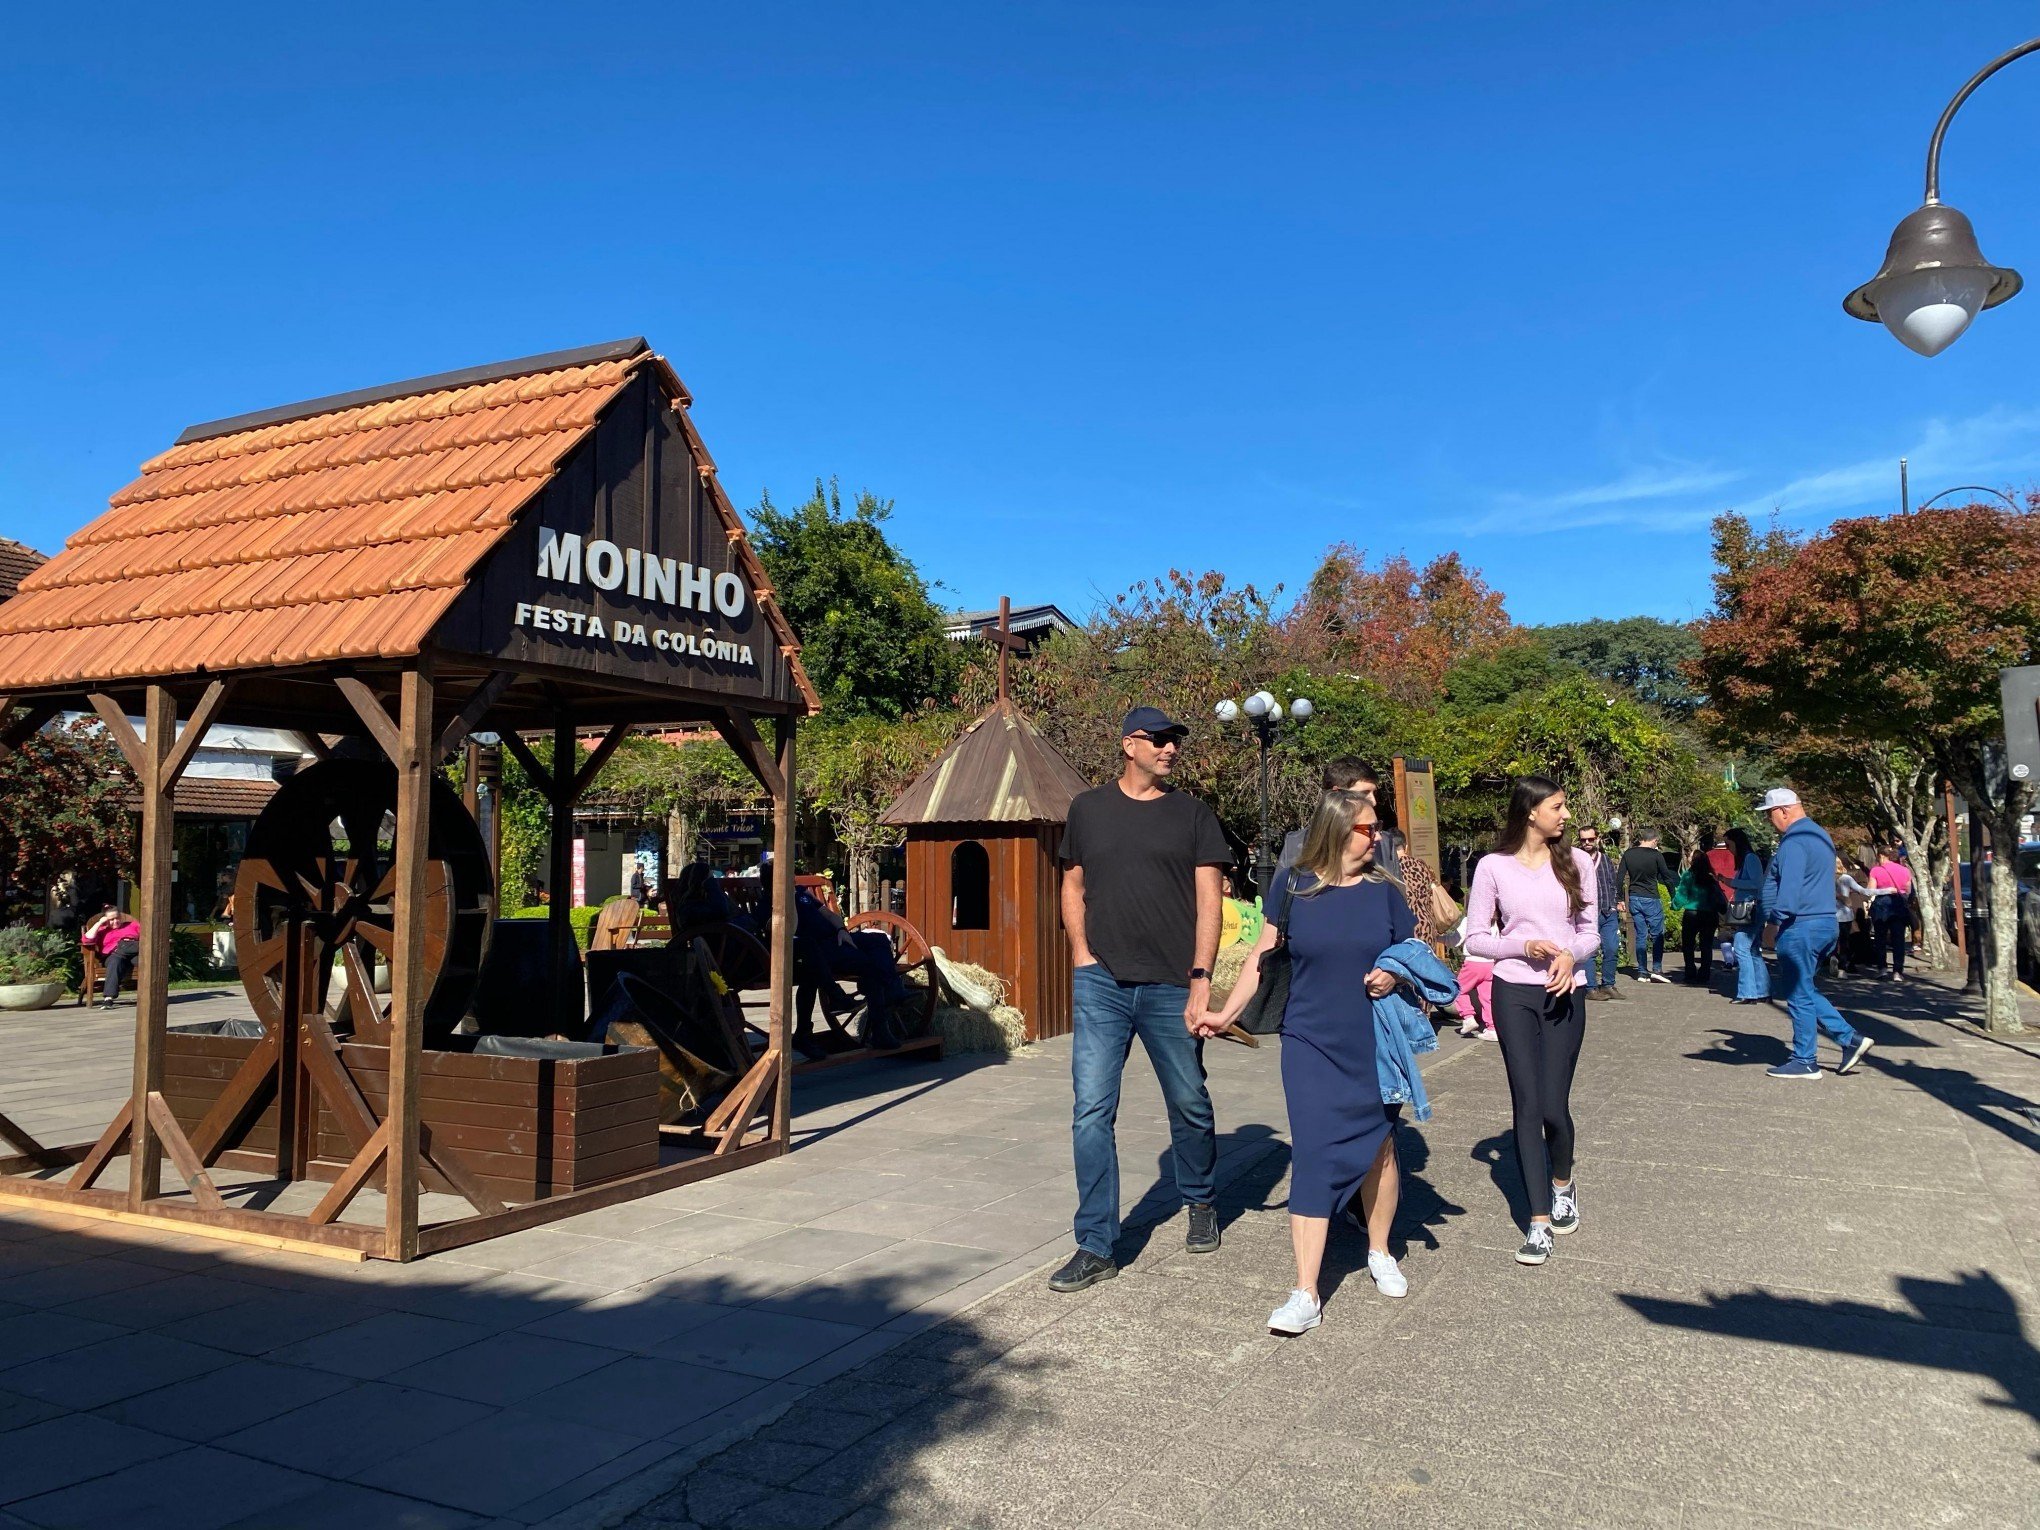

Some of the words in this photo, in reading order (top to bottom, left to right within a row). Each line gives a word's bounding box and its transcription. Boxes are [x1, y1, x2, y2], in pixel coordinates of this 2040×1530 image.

[537, 526, 745, 618] MOINHO
[514, 602, 606, 638] FESTA
[614, 620, 648, 647] DA
[652, 627, 754, 665] COLÔNIA
